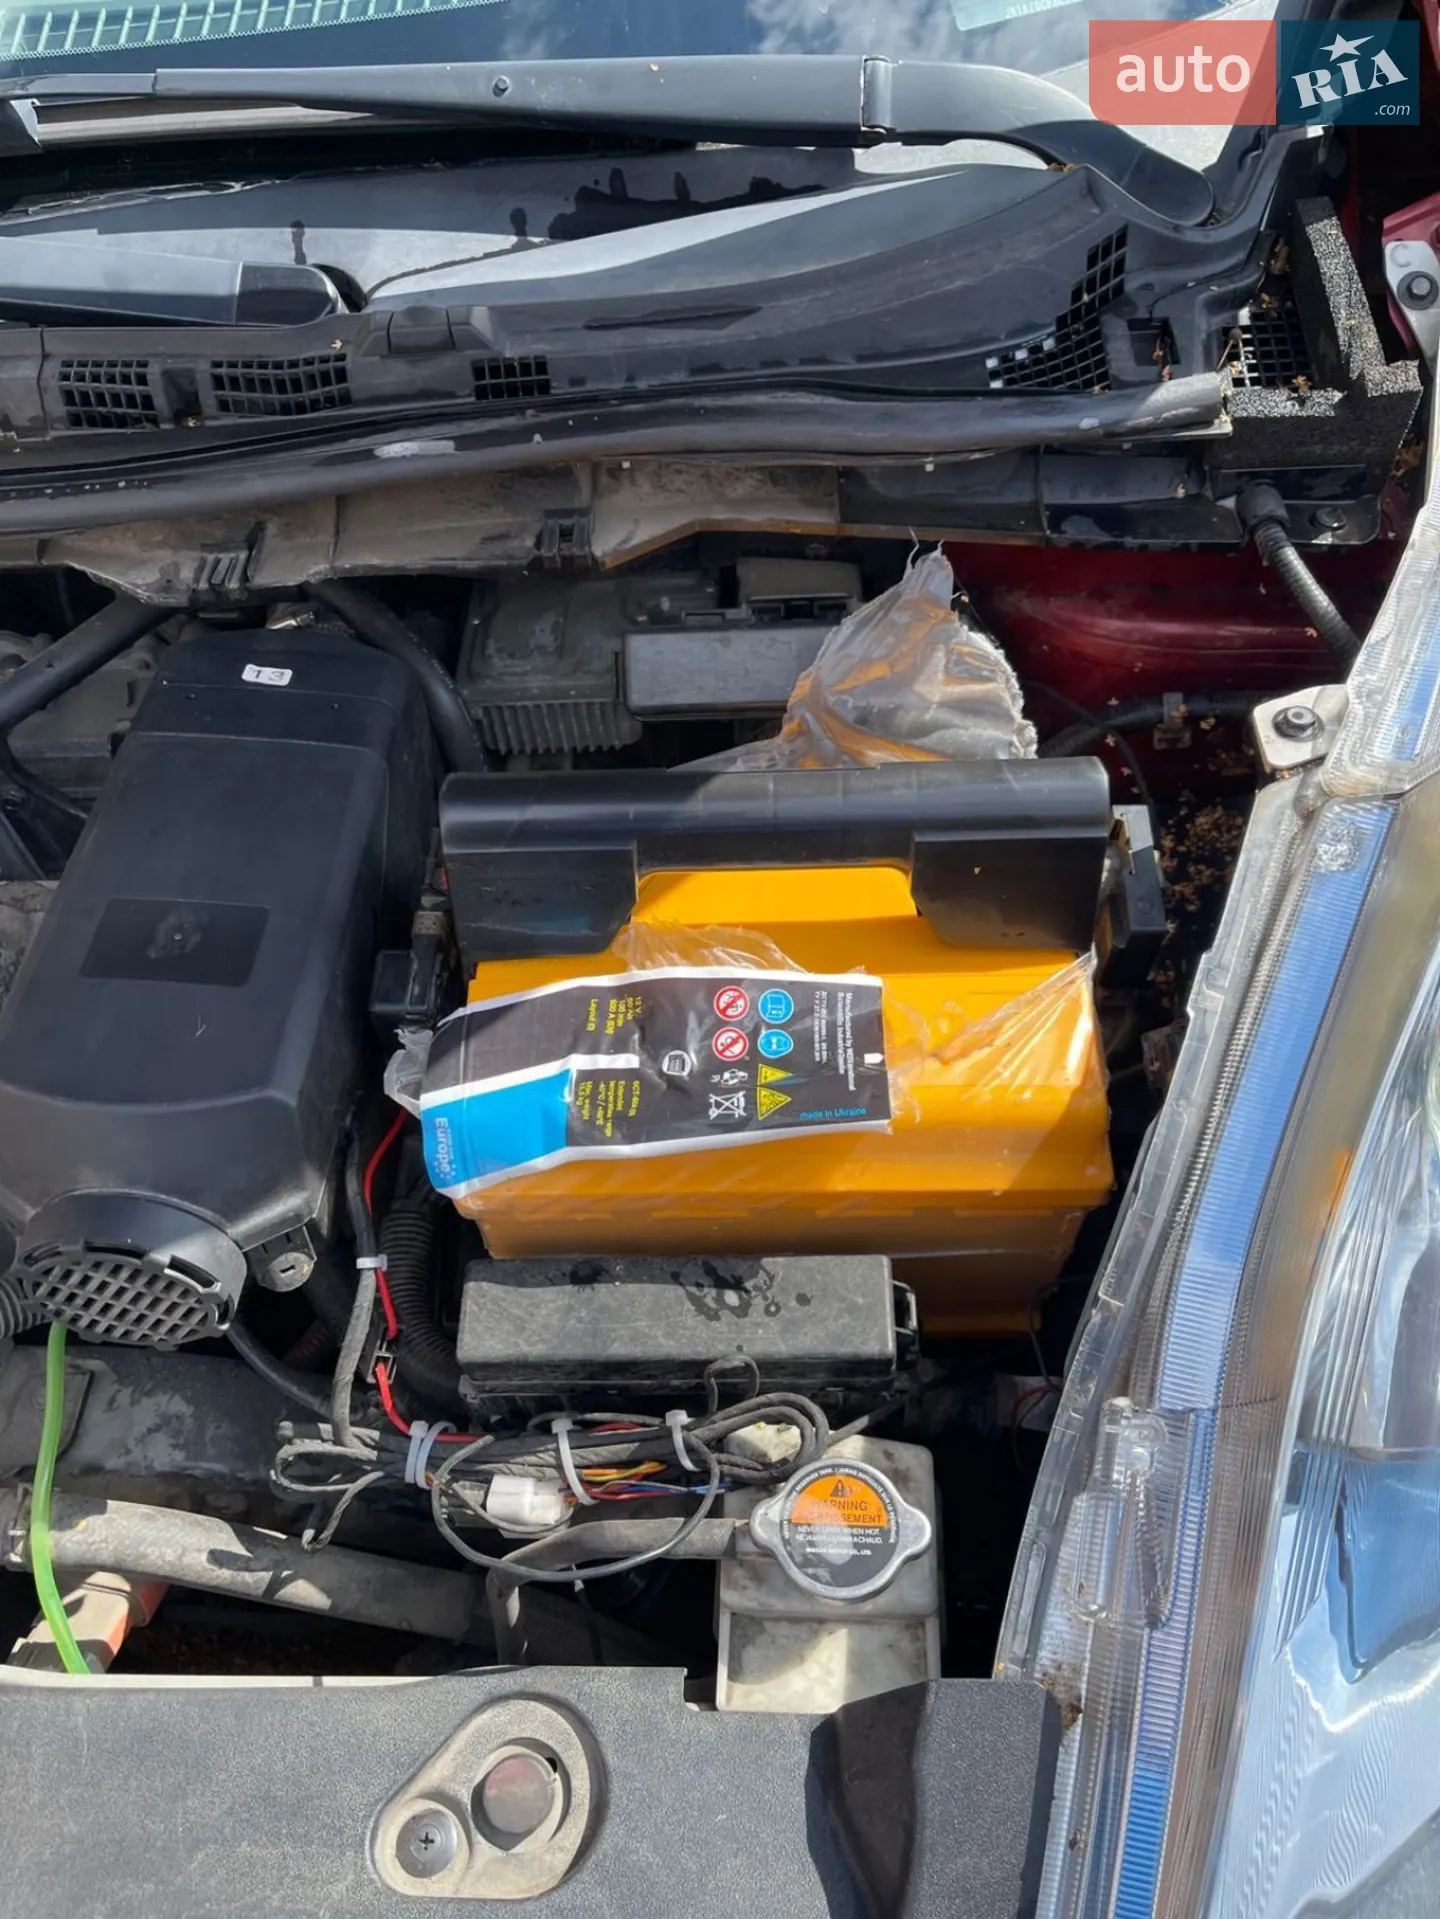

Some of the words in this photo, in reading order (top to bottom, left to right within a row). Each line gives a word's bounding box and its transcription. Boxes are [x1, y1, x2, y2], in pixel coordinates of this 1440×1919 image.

[589, 998, 598, 1021] Layout
[837, 992, 845, 1026] Scientific
[845, 992, 853, 1038] Manufactured
[800, 1109, 823, 1120] made
[834, 1106, 867, 1117] Ukraine
[435, 1117, 450, 1173] Europe
